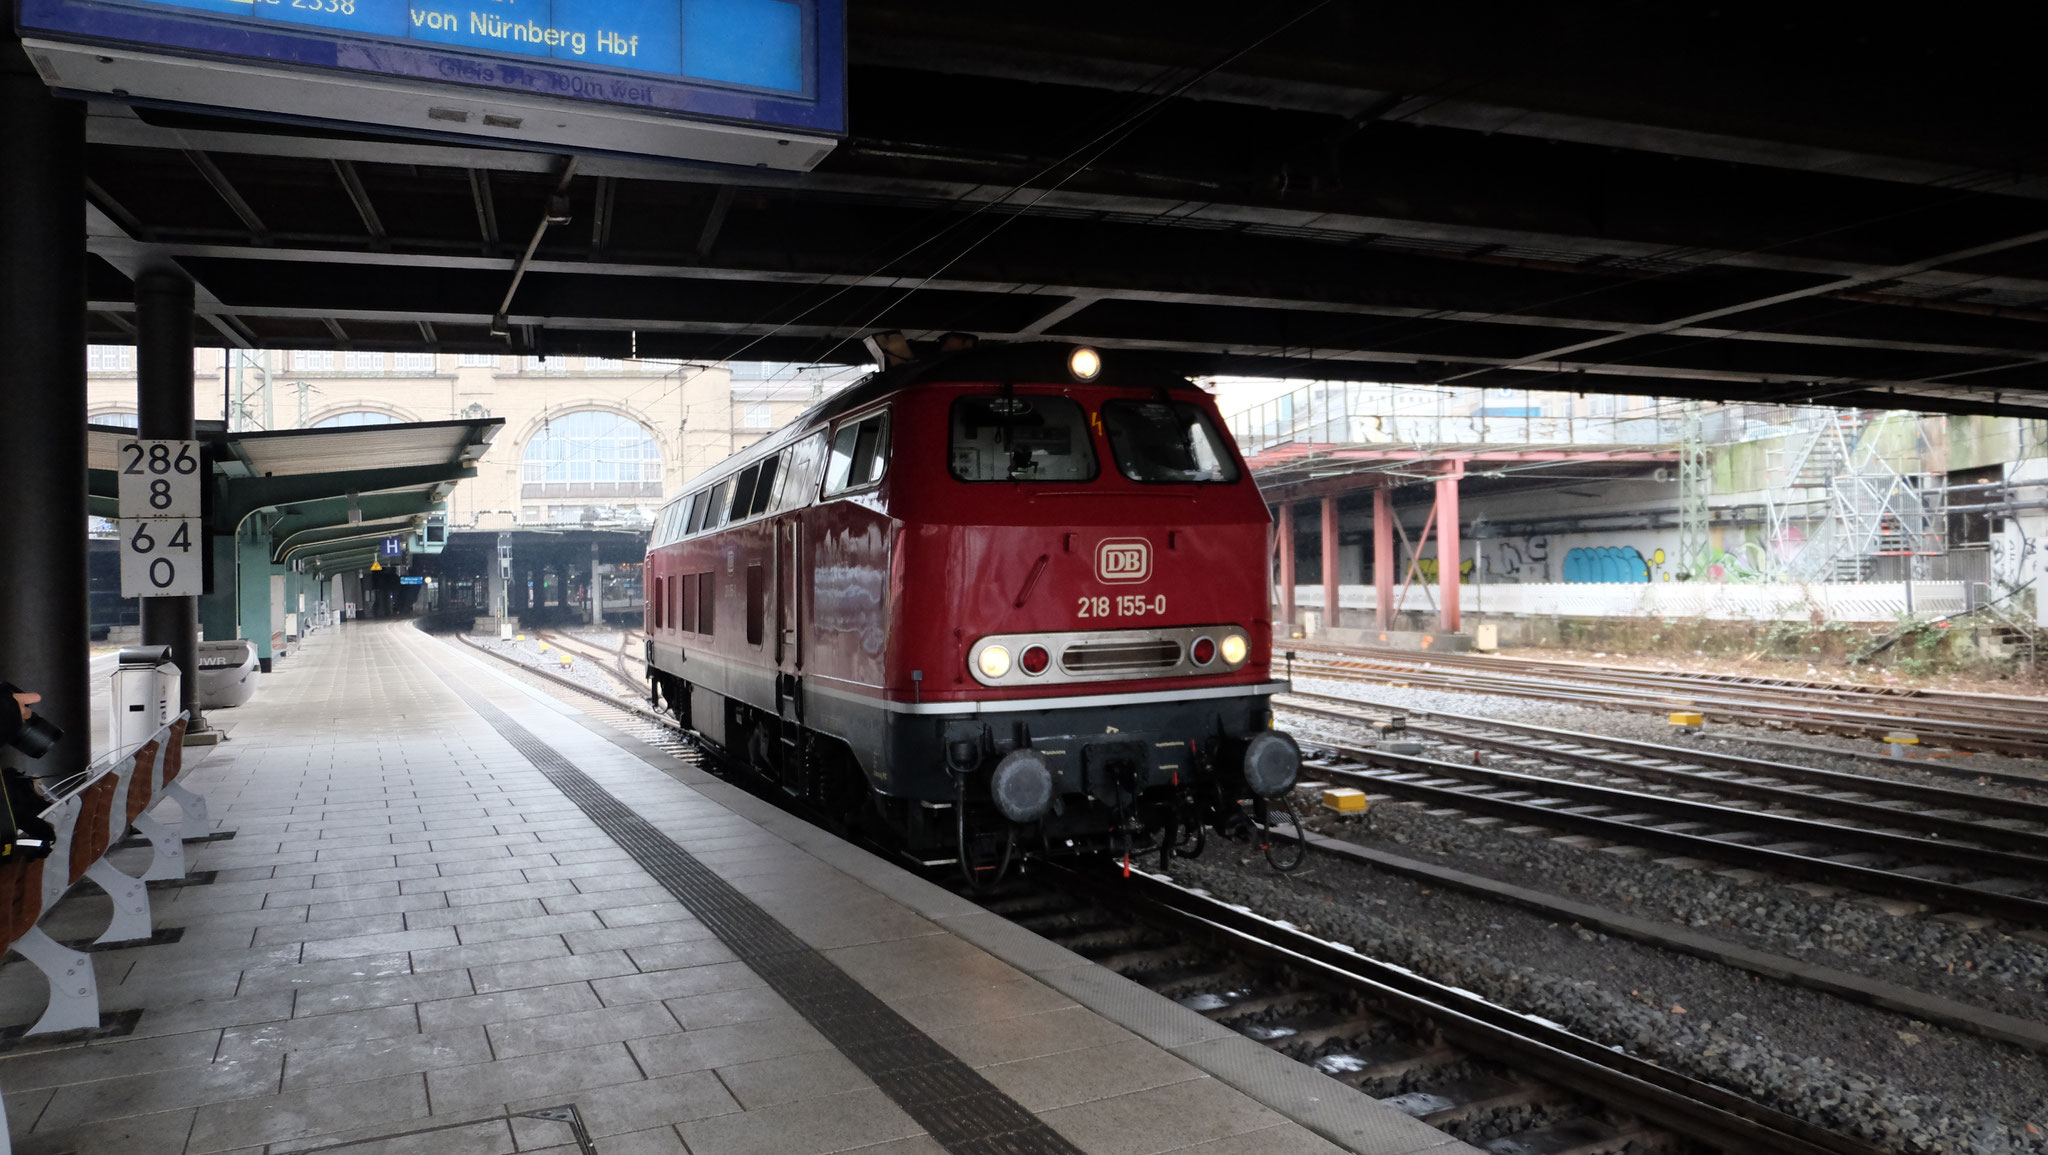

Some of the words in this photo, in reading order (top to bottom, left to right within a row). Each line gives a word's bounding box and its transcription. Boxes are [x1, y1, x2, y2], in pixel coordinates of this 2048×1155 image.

[411, 9, 458, 32] von
[471, 11, 586, 55] Nürnberg
[597, 30, 639, 57] Hbf
[122, 444, 198, 475] 286
[149, 479, 172, 510] 8
[386, 539, 398, 554] H
[1107, 551, 1140, 572] DB
[149, 557, 175, 588] 0
[1077, 596, 1110, 618] 218
[1116, 594, 1166, 617] 155-0
